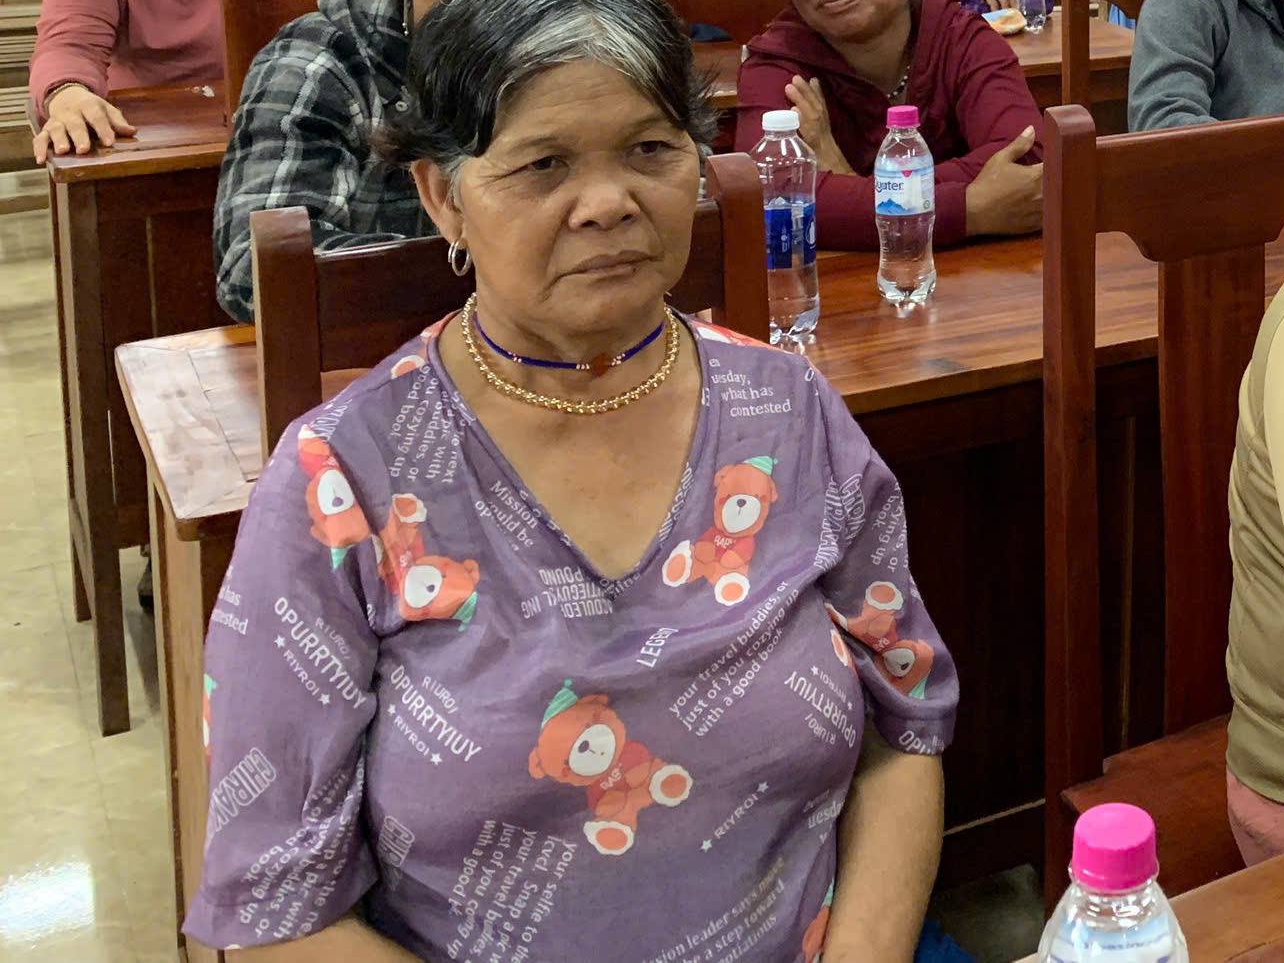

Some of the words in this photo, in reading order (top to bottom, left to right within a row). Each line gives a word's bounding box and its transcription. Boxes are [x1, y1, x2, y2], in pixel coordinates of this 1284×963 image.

[730, 399, 792, 417] contested
[750, 387, 774, 399] has
[490, 480, 538, 529] Mission
[517, 528, 533, 547] be
[274, 597, 367, 709] OPURRTYIUY
[669, 681, 698, 718] your
[699, 643, 738, 682] travel
[679, 699, 709, 731] just
[707, 679, 721, 699] of
[720, 657, 745, 685] you
[695, 705, 725, 737] with
[723, 695, 733, 707] a
[732, 661, 761, 697] good
[390, 665, 482, 762] OPURRTYIUY
[472, 848, 483, 857] a
[490, 851, 503, 869] of
[516, 829, 537, 863] your
[554, 841, 577, 879] your
[453, 857, 478, 897] good
[475, 867, 495, 896] you
[494, 865, 523, 909] travel
[510, 881, 538, 918] Snap
[502, 921, 514, 932] a
[521, 926, 538, 942] to
[687, 911, 730, 949] leader
[715, 924, 745, 951] step
